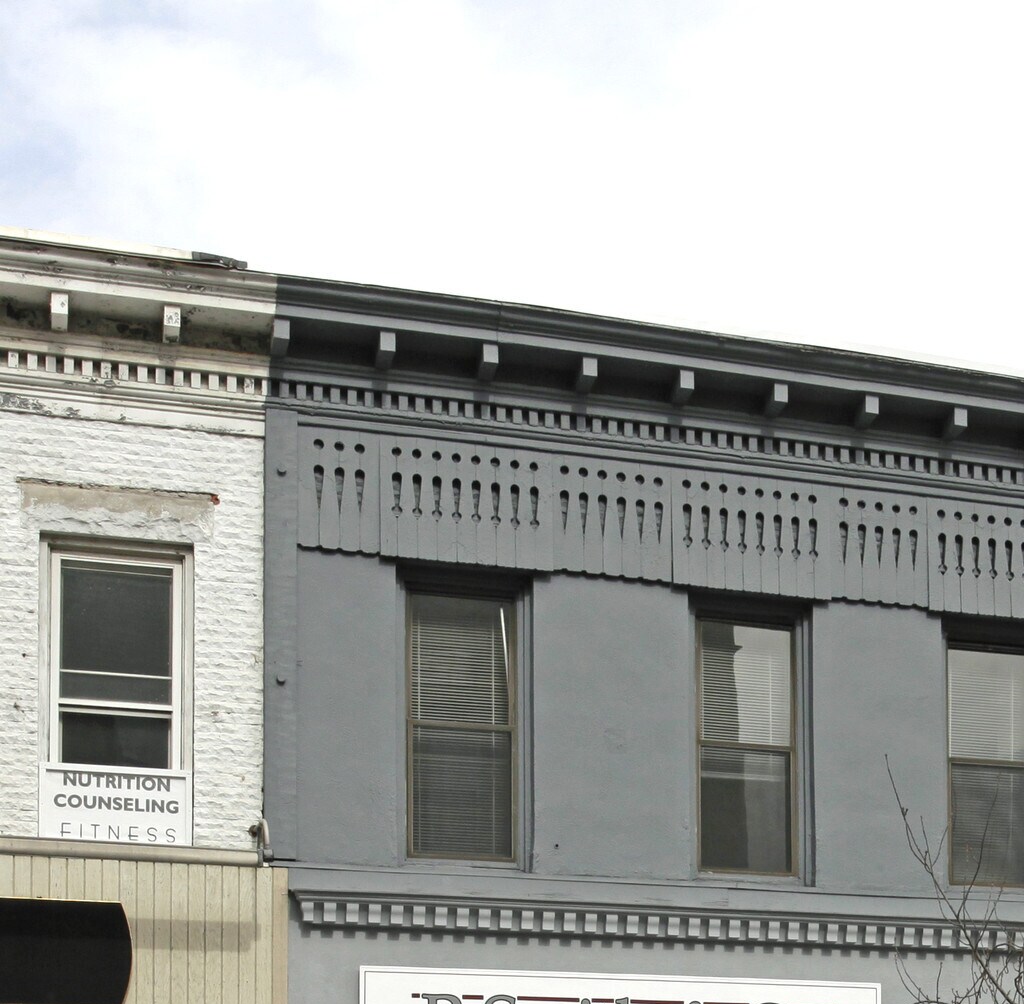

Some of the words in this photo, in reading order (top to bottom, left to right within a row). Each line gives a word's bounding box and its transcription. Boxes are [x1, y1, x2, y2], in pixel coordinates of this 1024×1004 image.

[62, 772, 171, 792] NUTRITION
[53, 794, 179, 814] COUNSELING
[60, 822, 177, 843] FITNESS
